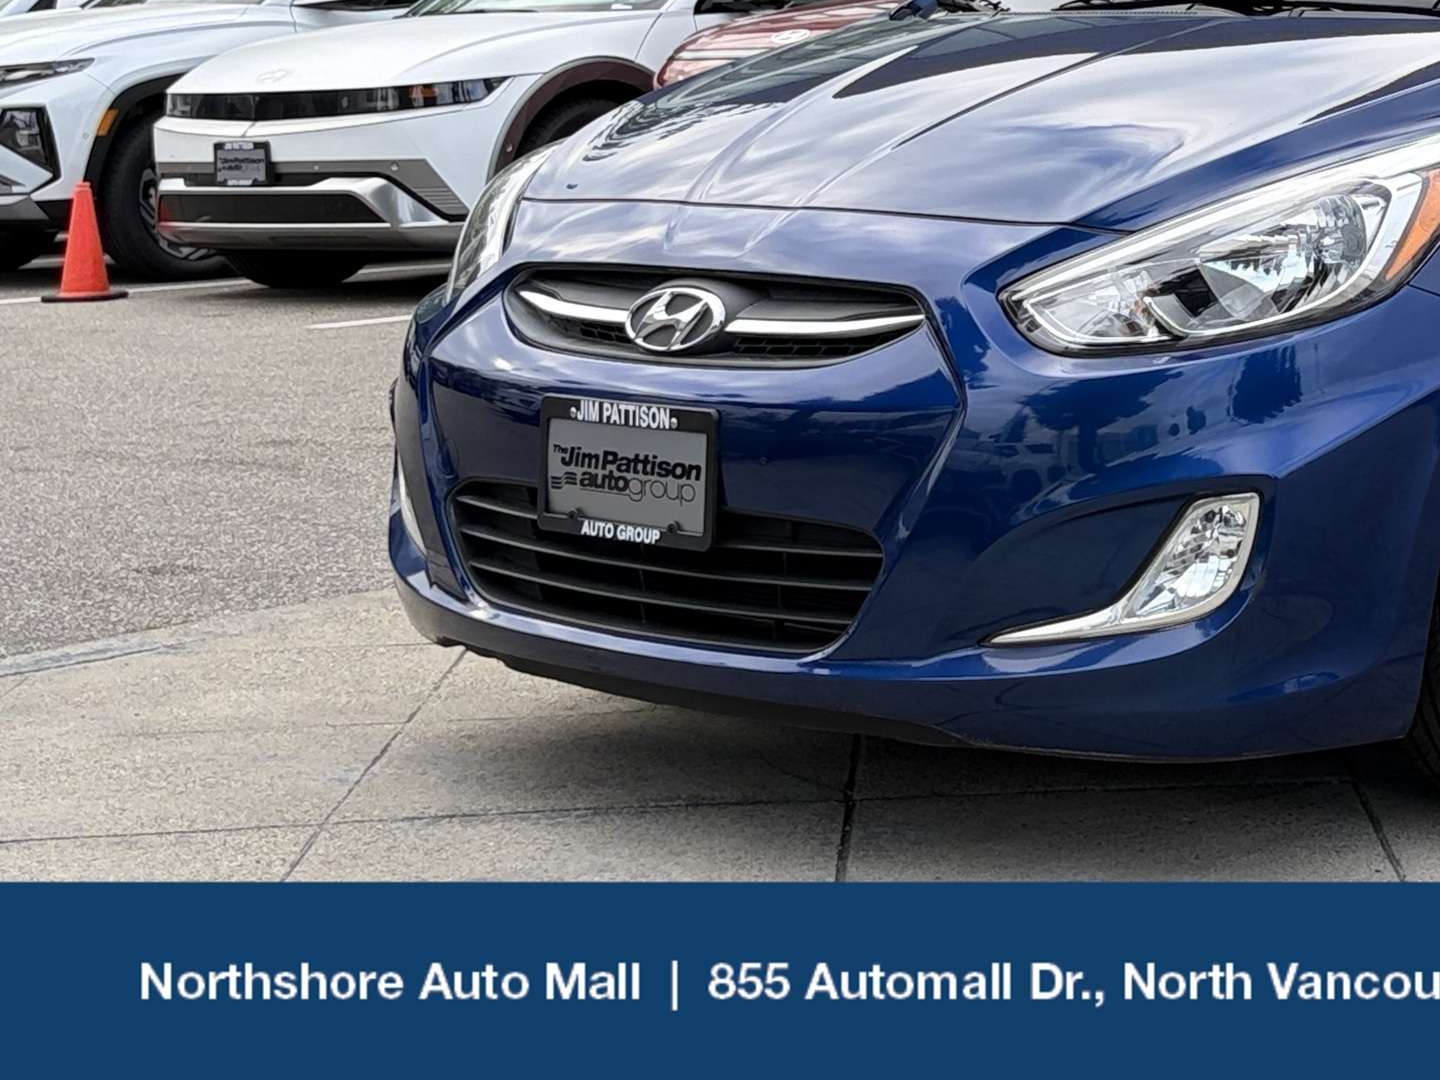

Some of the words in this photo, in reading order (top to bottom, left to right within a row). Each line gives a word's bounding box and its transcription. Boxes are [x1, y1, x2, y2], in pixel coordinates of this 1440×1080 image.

[577, 399, 600, 422] JIM
[603, 401, 670, 429] PATTISON
[581, 520, 614, 539] AUTO
[617, 525, 660, 544] GROUP
